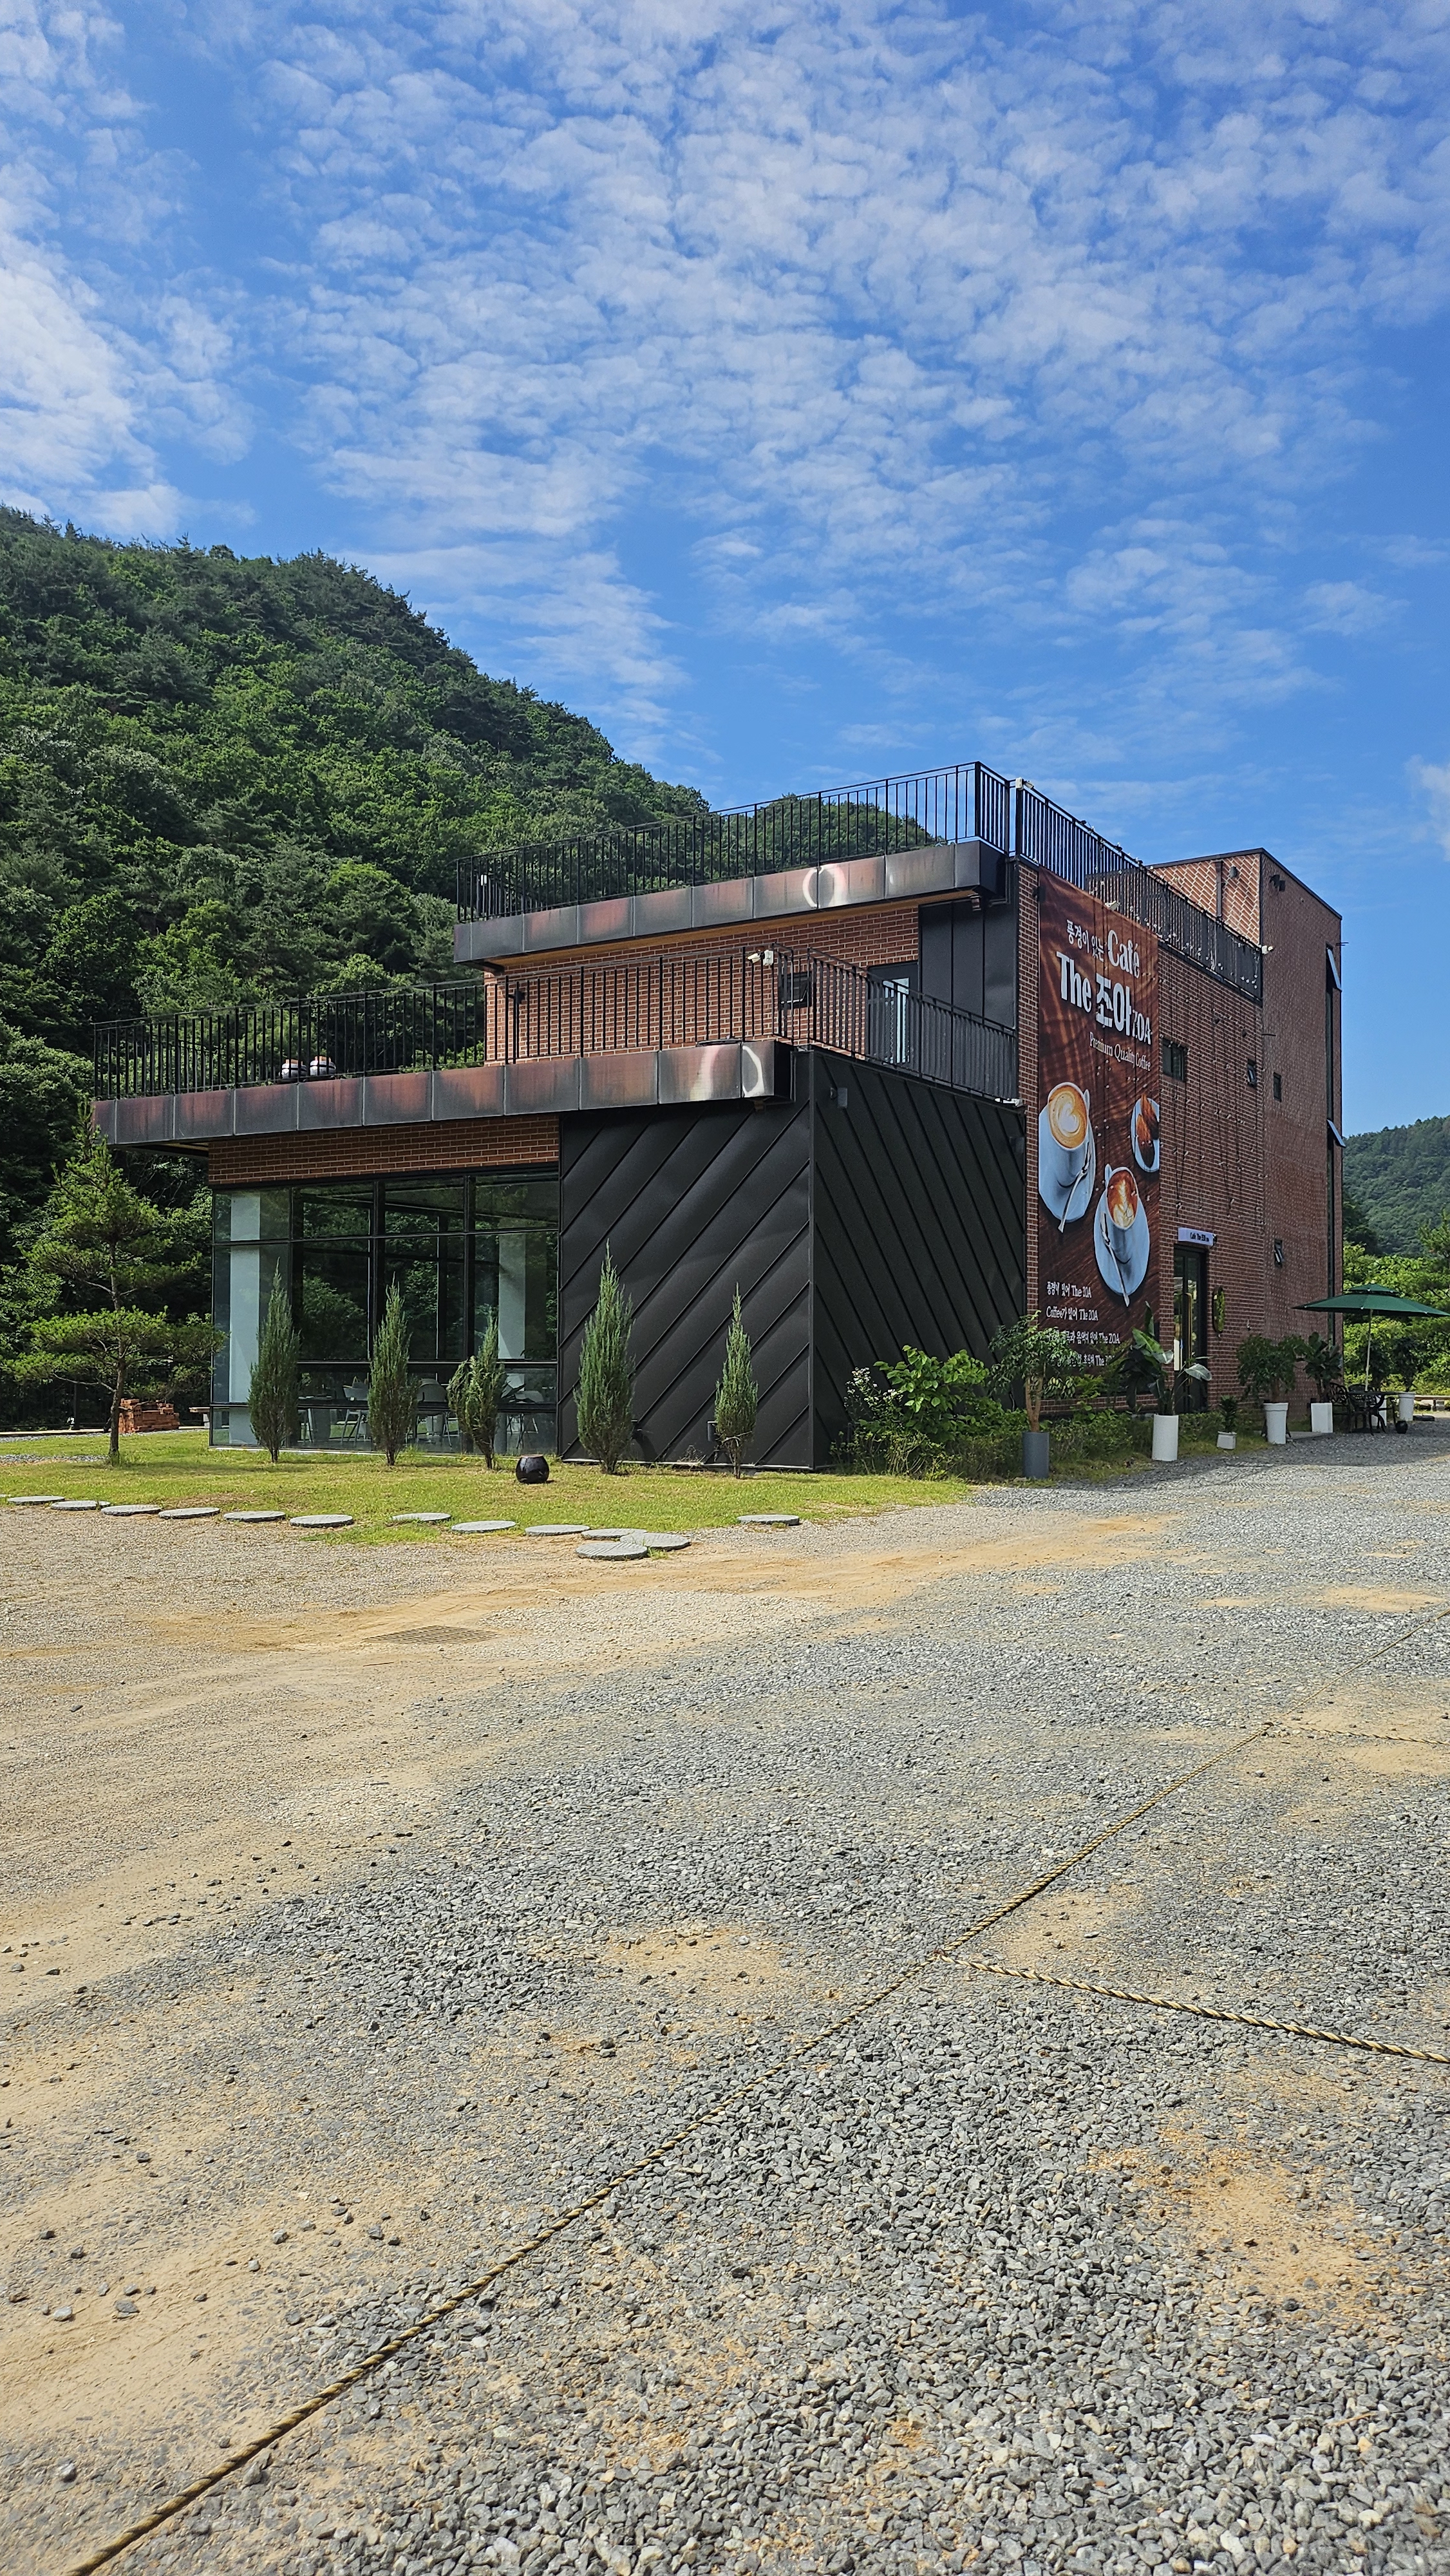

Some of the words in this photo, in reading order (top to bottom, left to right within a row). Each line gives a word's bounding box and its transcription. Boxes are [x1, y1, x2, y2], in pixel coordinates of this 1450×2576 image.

[1067, 919, 1089, 953] 풍경이
[1091, 935, 1104, 962] 있는
[1107, 929, 1140, 978] Café
[1057, 951, 1091, 1013] The
[1089, 1031, 1113, 1057] Premium
[1114, 1043, 1135, 1068] Quality
[1135, 1052, 1151, 1072] Coffee
[1071, 1285, 1082, 1298] The
[1079, 1309, 1088, 1320] The
[1088, 1309, 1098, 1321] ZOA
[1098, 1332, 1108, 1344] The
[1108, 1332, 1120, 1344] ZOA
[1095, 1354, 1105, 1367] The
